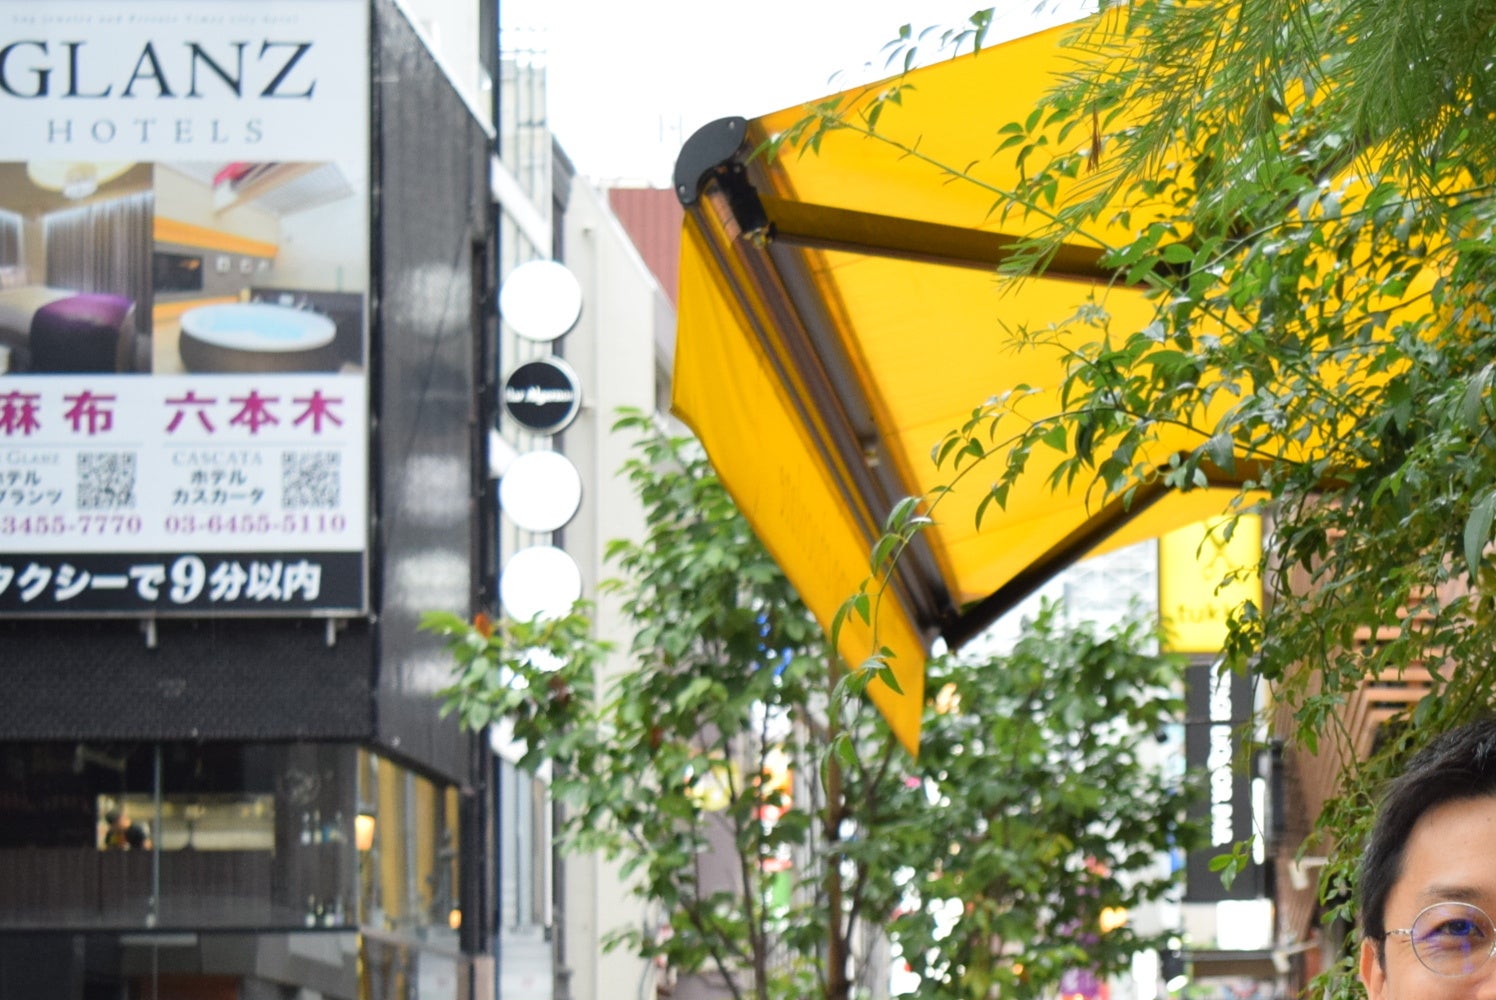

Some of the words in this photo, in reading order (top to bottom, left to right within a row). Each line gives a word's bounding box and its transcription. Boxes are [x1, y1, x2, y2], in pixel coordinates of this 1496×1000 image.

[0, 39, 317, 100] GLANZ
[47, 119, 265, 145] HOTELS
[0, 390, 117, 436] 麻布
[164, 390, 344, 436] 六本木
[0, 470, 42, 486] テル
[190, 469, 248, 486] ホテル
[172, 488, 265, 506] カスカータ
[164, 514, 347, 534] 03-6455-5110
